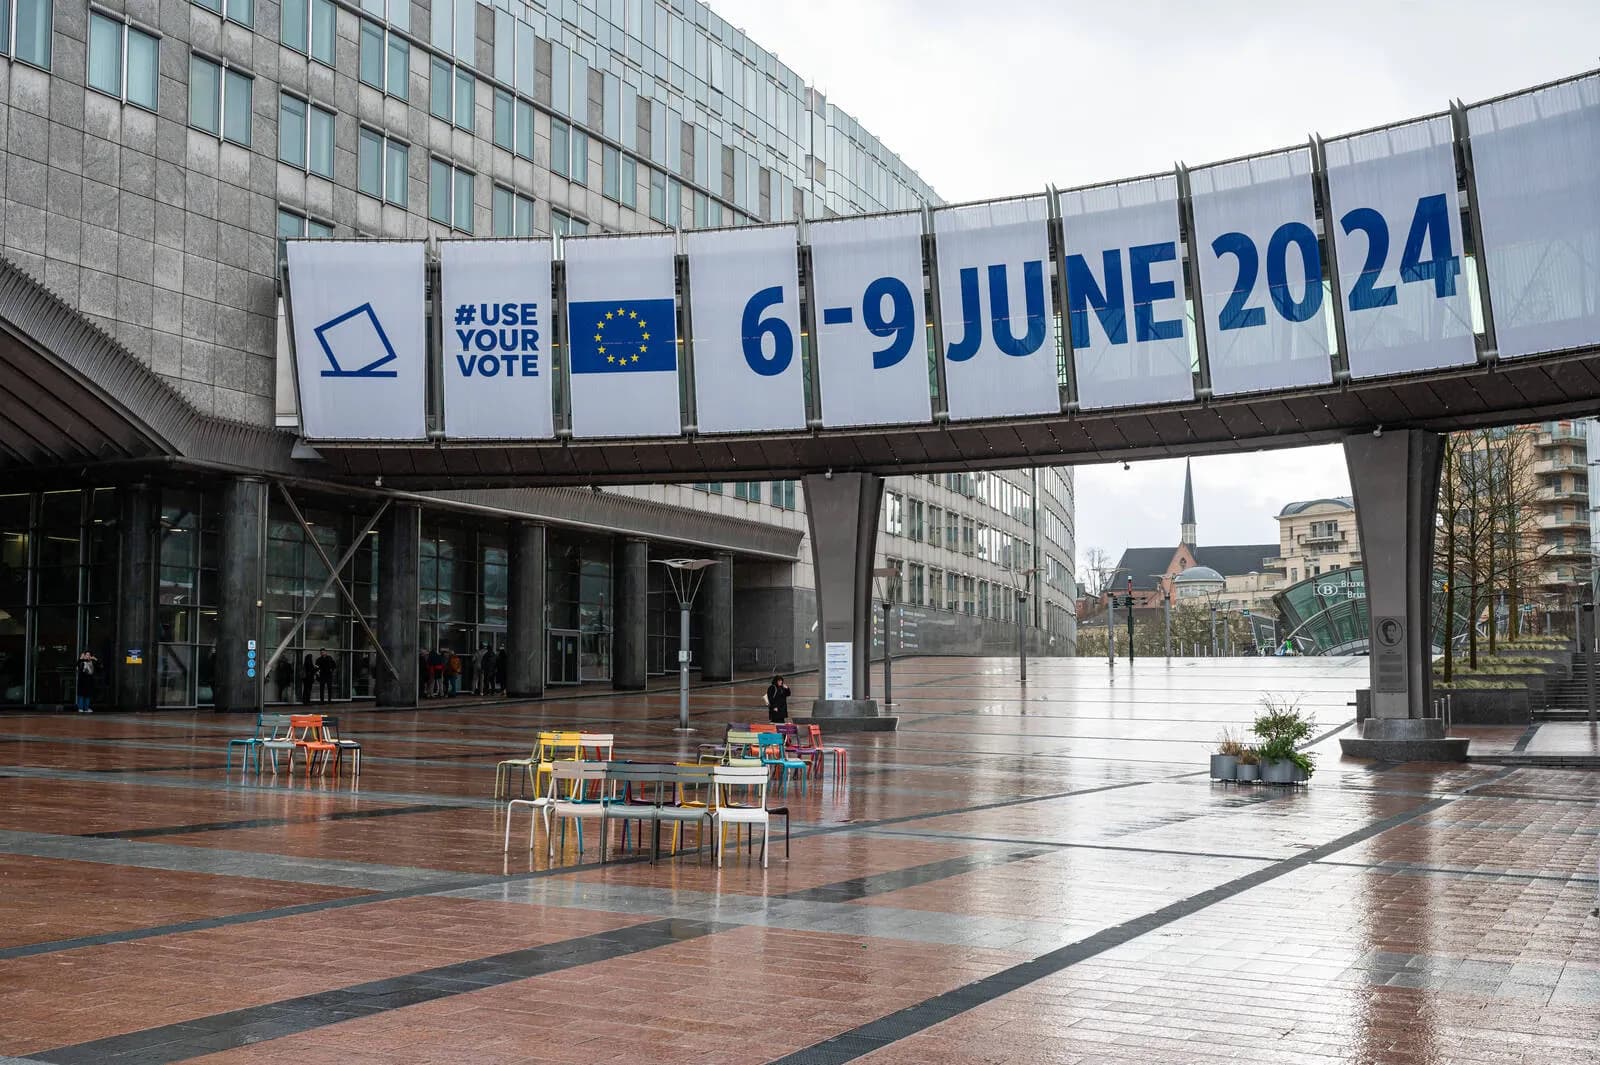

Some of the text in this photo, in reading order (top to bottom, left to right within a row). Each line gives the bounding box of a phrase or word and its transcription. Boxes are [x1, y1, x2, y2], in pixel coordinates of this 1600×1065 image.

[944, 240, 1186, 364] JUNE
[1210, 192, 1462, 332] 2024
[454, 303, 539, 326] #USE
[455, 328, 540, 352] YOUR
[456, 354, 540, 378] VOTE
